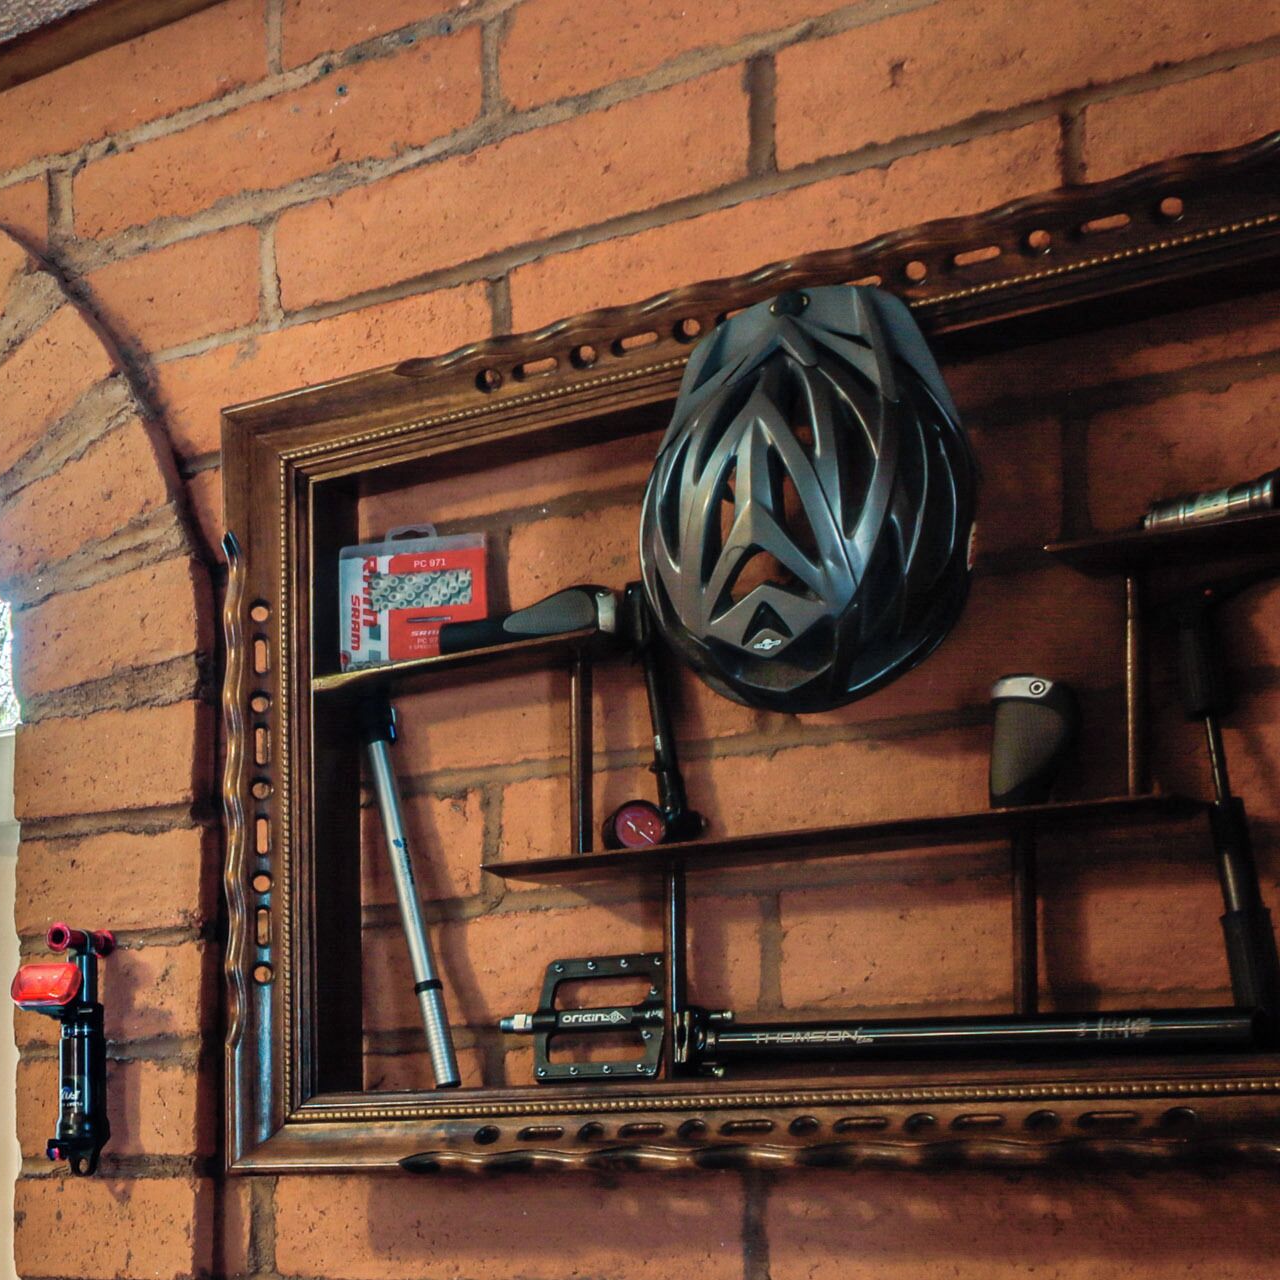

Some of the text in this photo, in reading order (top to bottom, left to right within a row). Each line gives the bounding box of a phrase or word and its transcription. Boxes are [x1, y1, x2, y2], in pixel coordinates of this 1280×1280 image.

[413, 558, 447, 569] PC 971
[351, 594, 361, 651] SRAM
[751, 1030, 858, 1044] THOMSON
